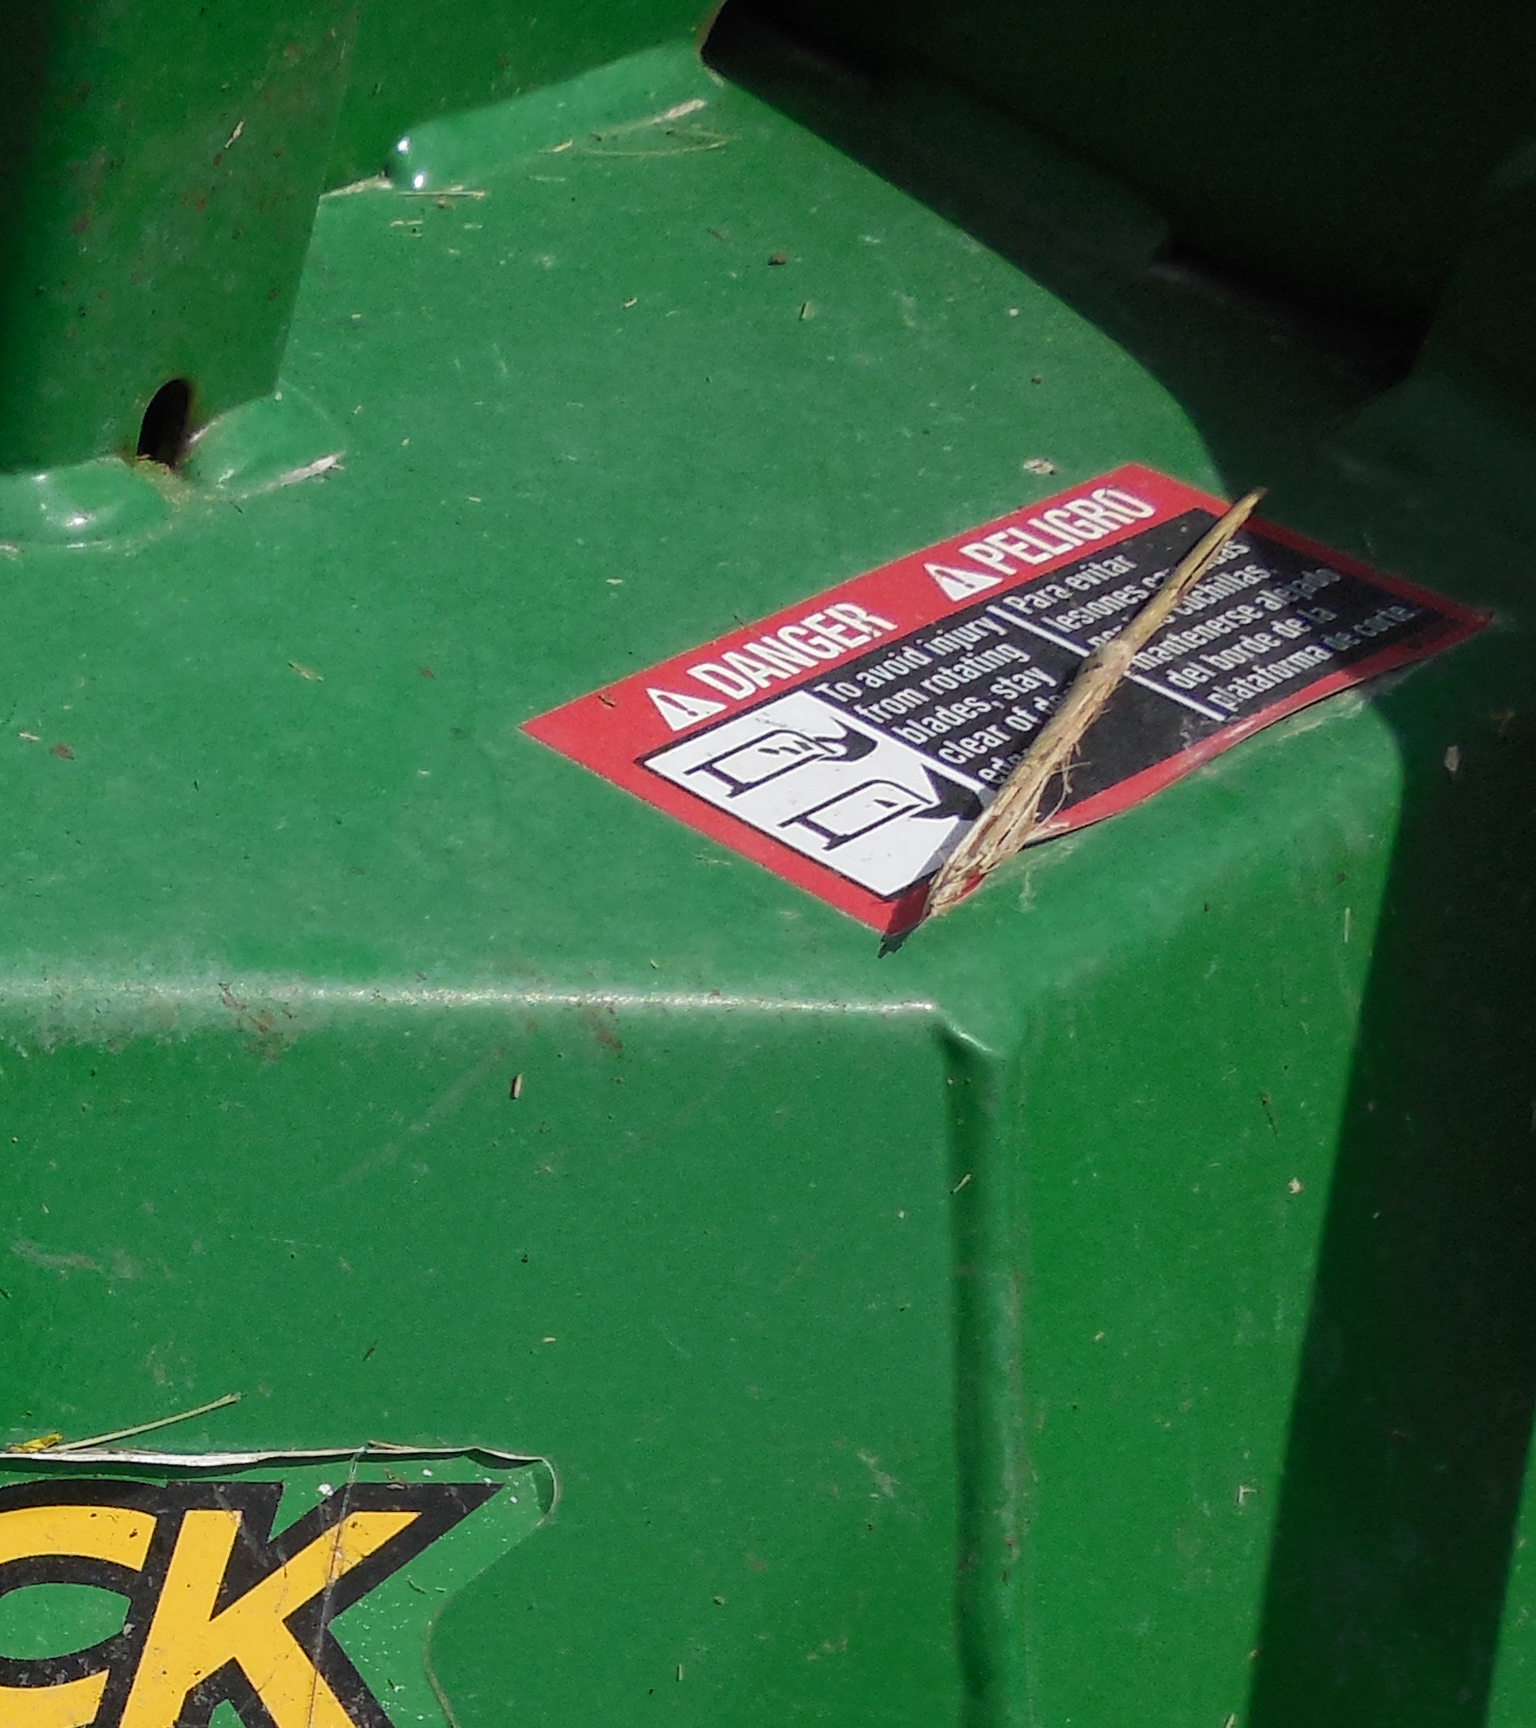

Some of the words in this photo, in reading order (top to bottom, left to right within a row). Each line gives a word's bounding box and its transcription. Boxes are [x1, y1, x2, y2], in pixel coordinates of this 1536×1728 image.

[959, 487, 1156, 576] PELIGRO
[1002, 582, 1073, 614] Para
[1065, 554, 1137, 591] evitar
[1041, 583, 1149, 634] lesiones
[687, 602, 897, 700] DANGER
[814, 682, 860, 702] To
[857, 647, 933, 689] avoid
[919, 615, 1008, 657] injury
[1131, 604, 1263, 672] mantenerse
[1167, 661, 1217, 690] del
[1199, 630, 1281, 673] borde
[1270, 616, 1312, 640] de
[853, 687, 929, 724] from
[920, 642, 1031, 694] rotating
[891, 695, 1005, 745] blades,
[990, 666, 1058, 702] stay
[1207, 645, 1334, 713] plataforma
[938, 723, 1011, 764] clear
[1007, 705, 1039, 733] of
